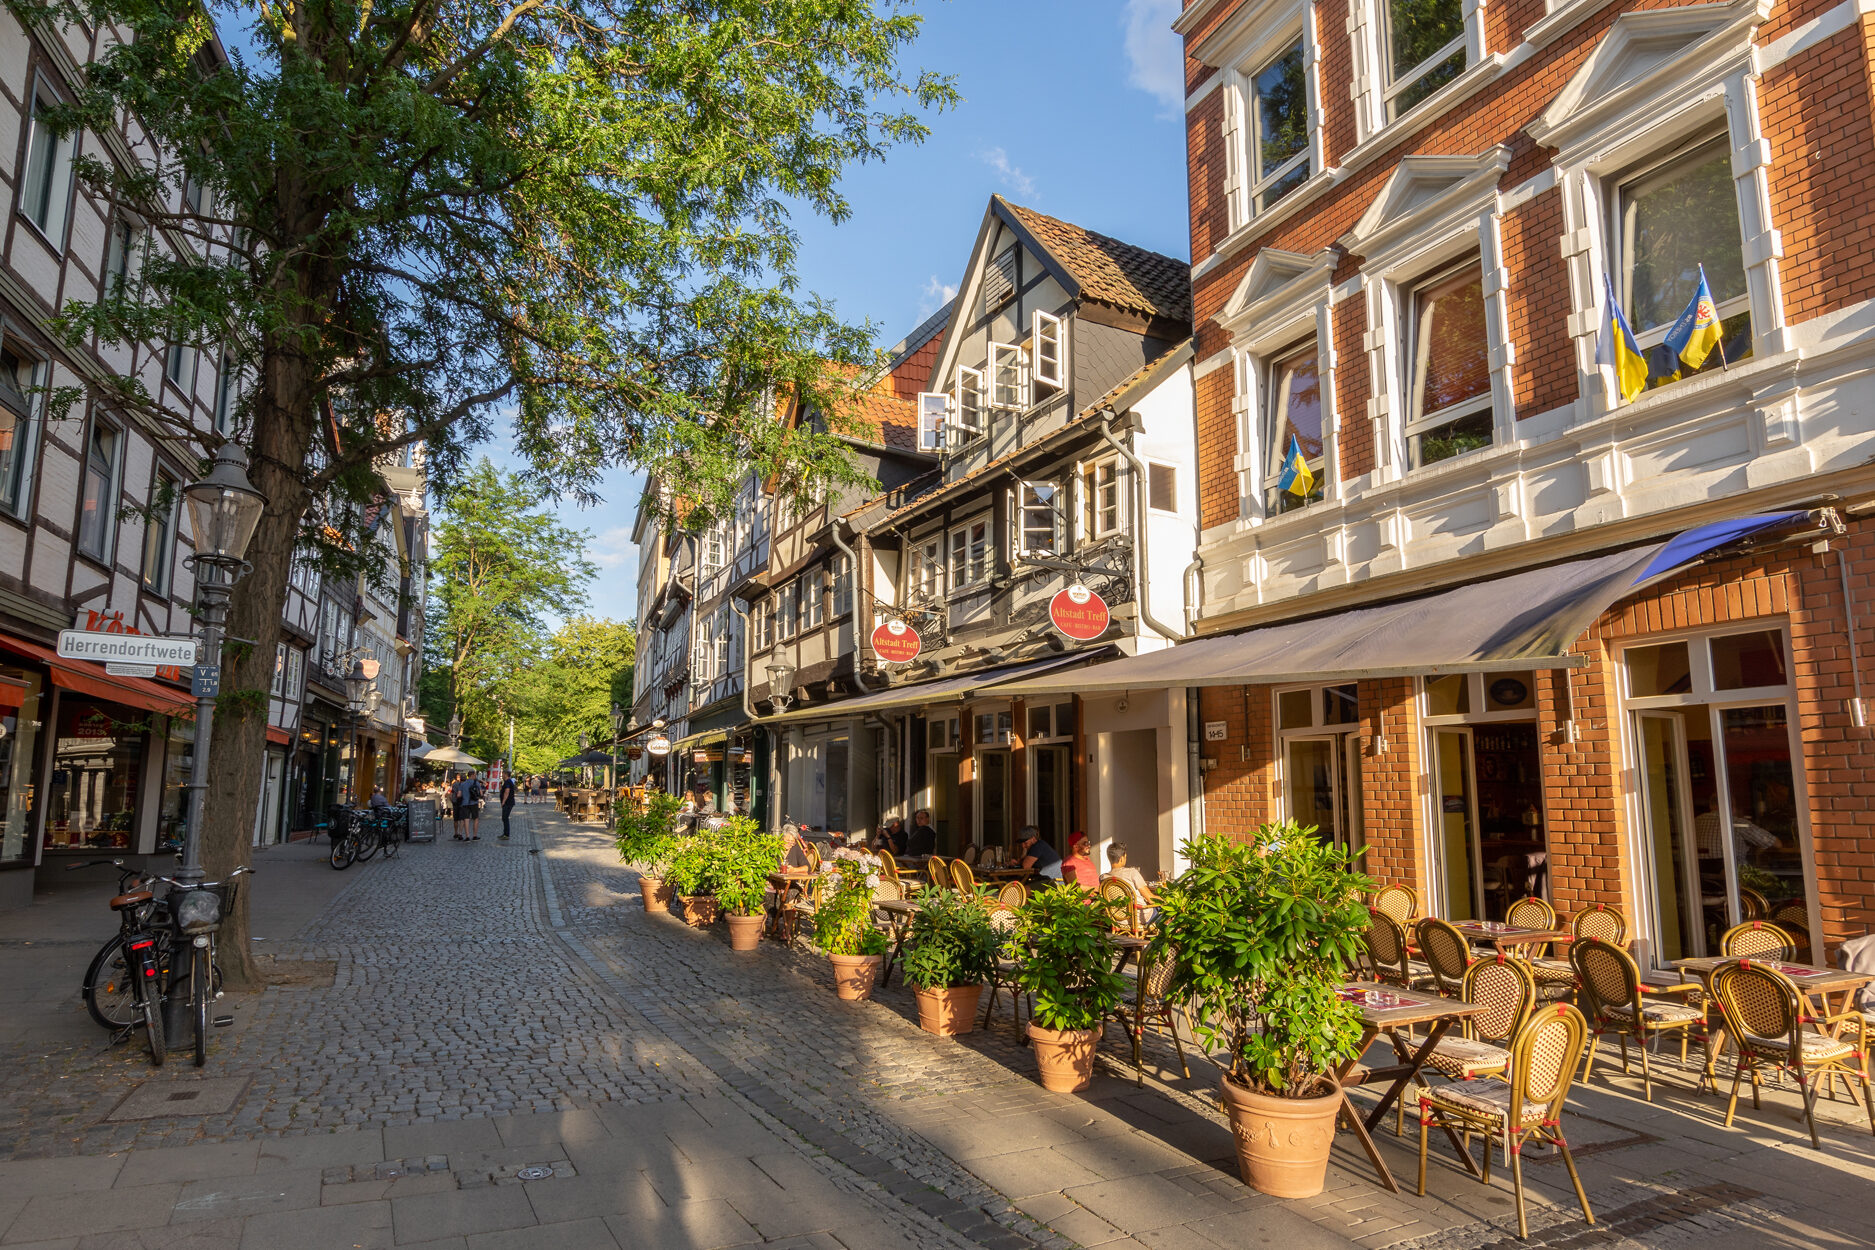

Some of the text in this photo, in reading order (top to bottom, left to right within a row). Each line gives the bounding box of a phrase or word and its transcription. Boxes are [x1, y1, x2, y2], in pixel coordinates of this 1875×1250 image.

[1053, 607, 1107, 622] Altstadt Treff
[64, 636, 192, 660] Herrendorftwete
[873, 637, 919, 649] Altstadt Treff
